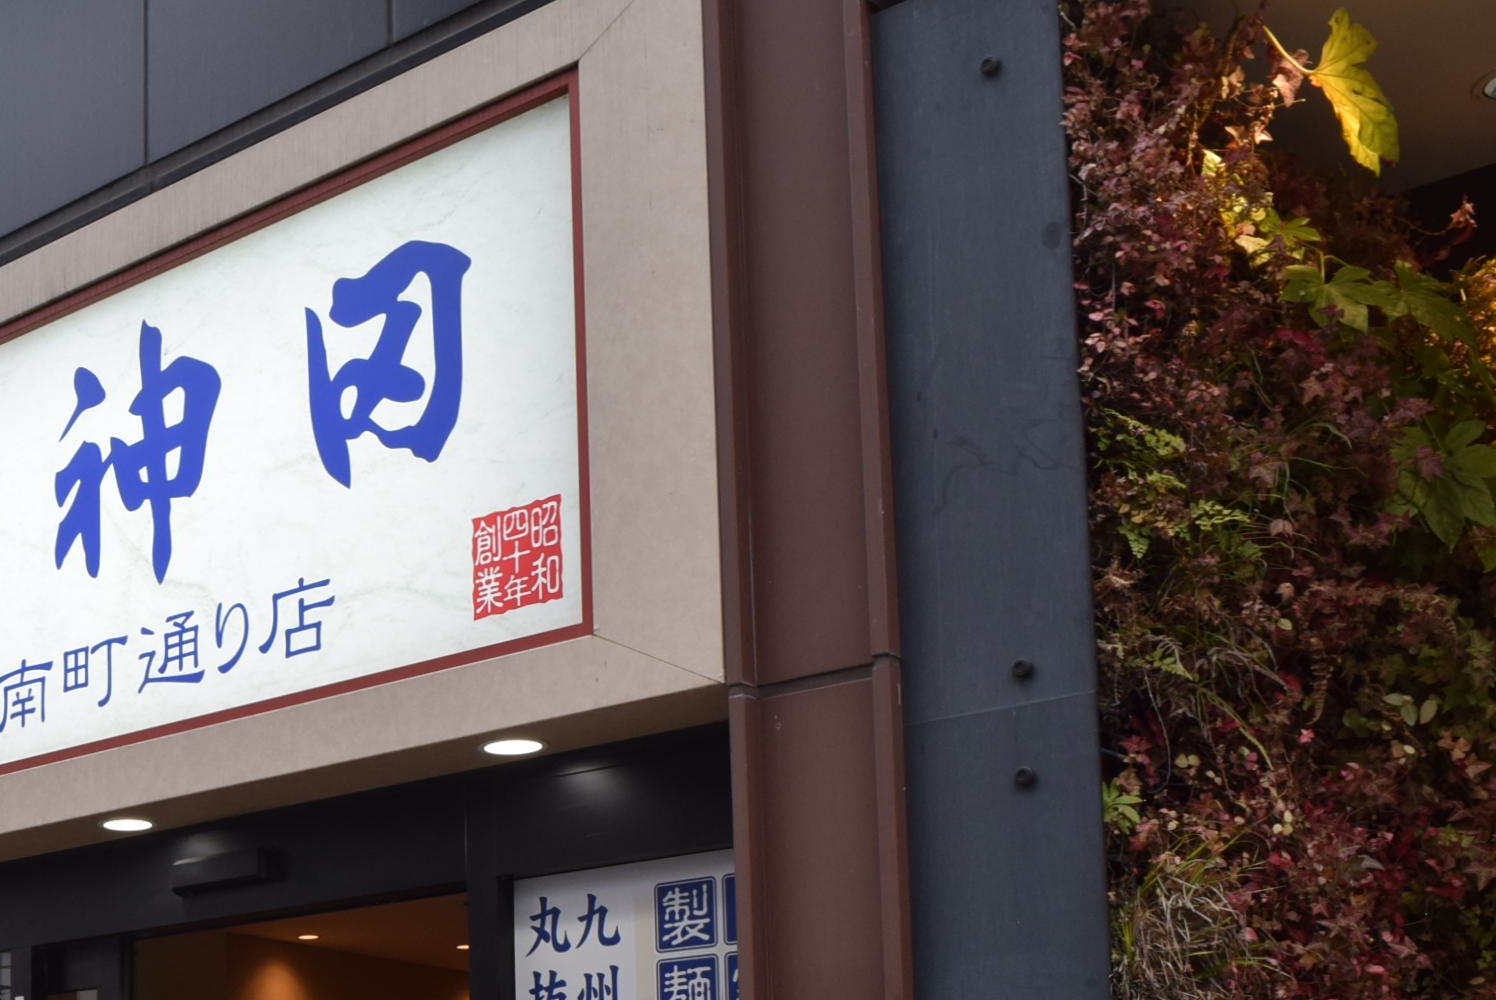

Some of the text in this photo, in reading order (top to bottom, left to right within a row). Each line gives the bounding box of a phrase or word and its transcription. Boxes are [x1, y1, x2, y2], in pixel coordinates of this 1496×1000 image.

[474, 514, 504, 614] 創業
[503, 509, 532, 607] 四十年
[530, 501, 560, 600] 昭和
